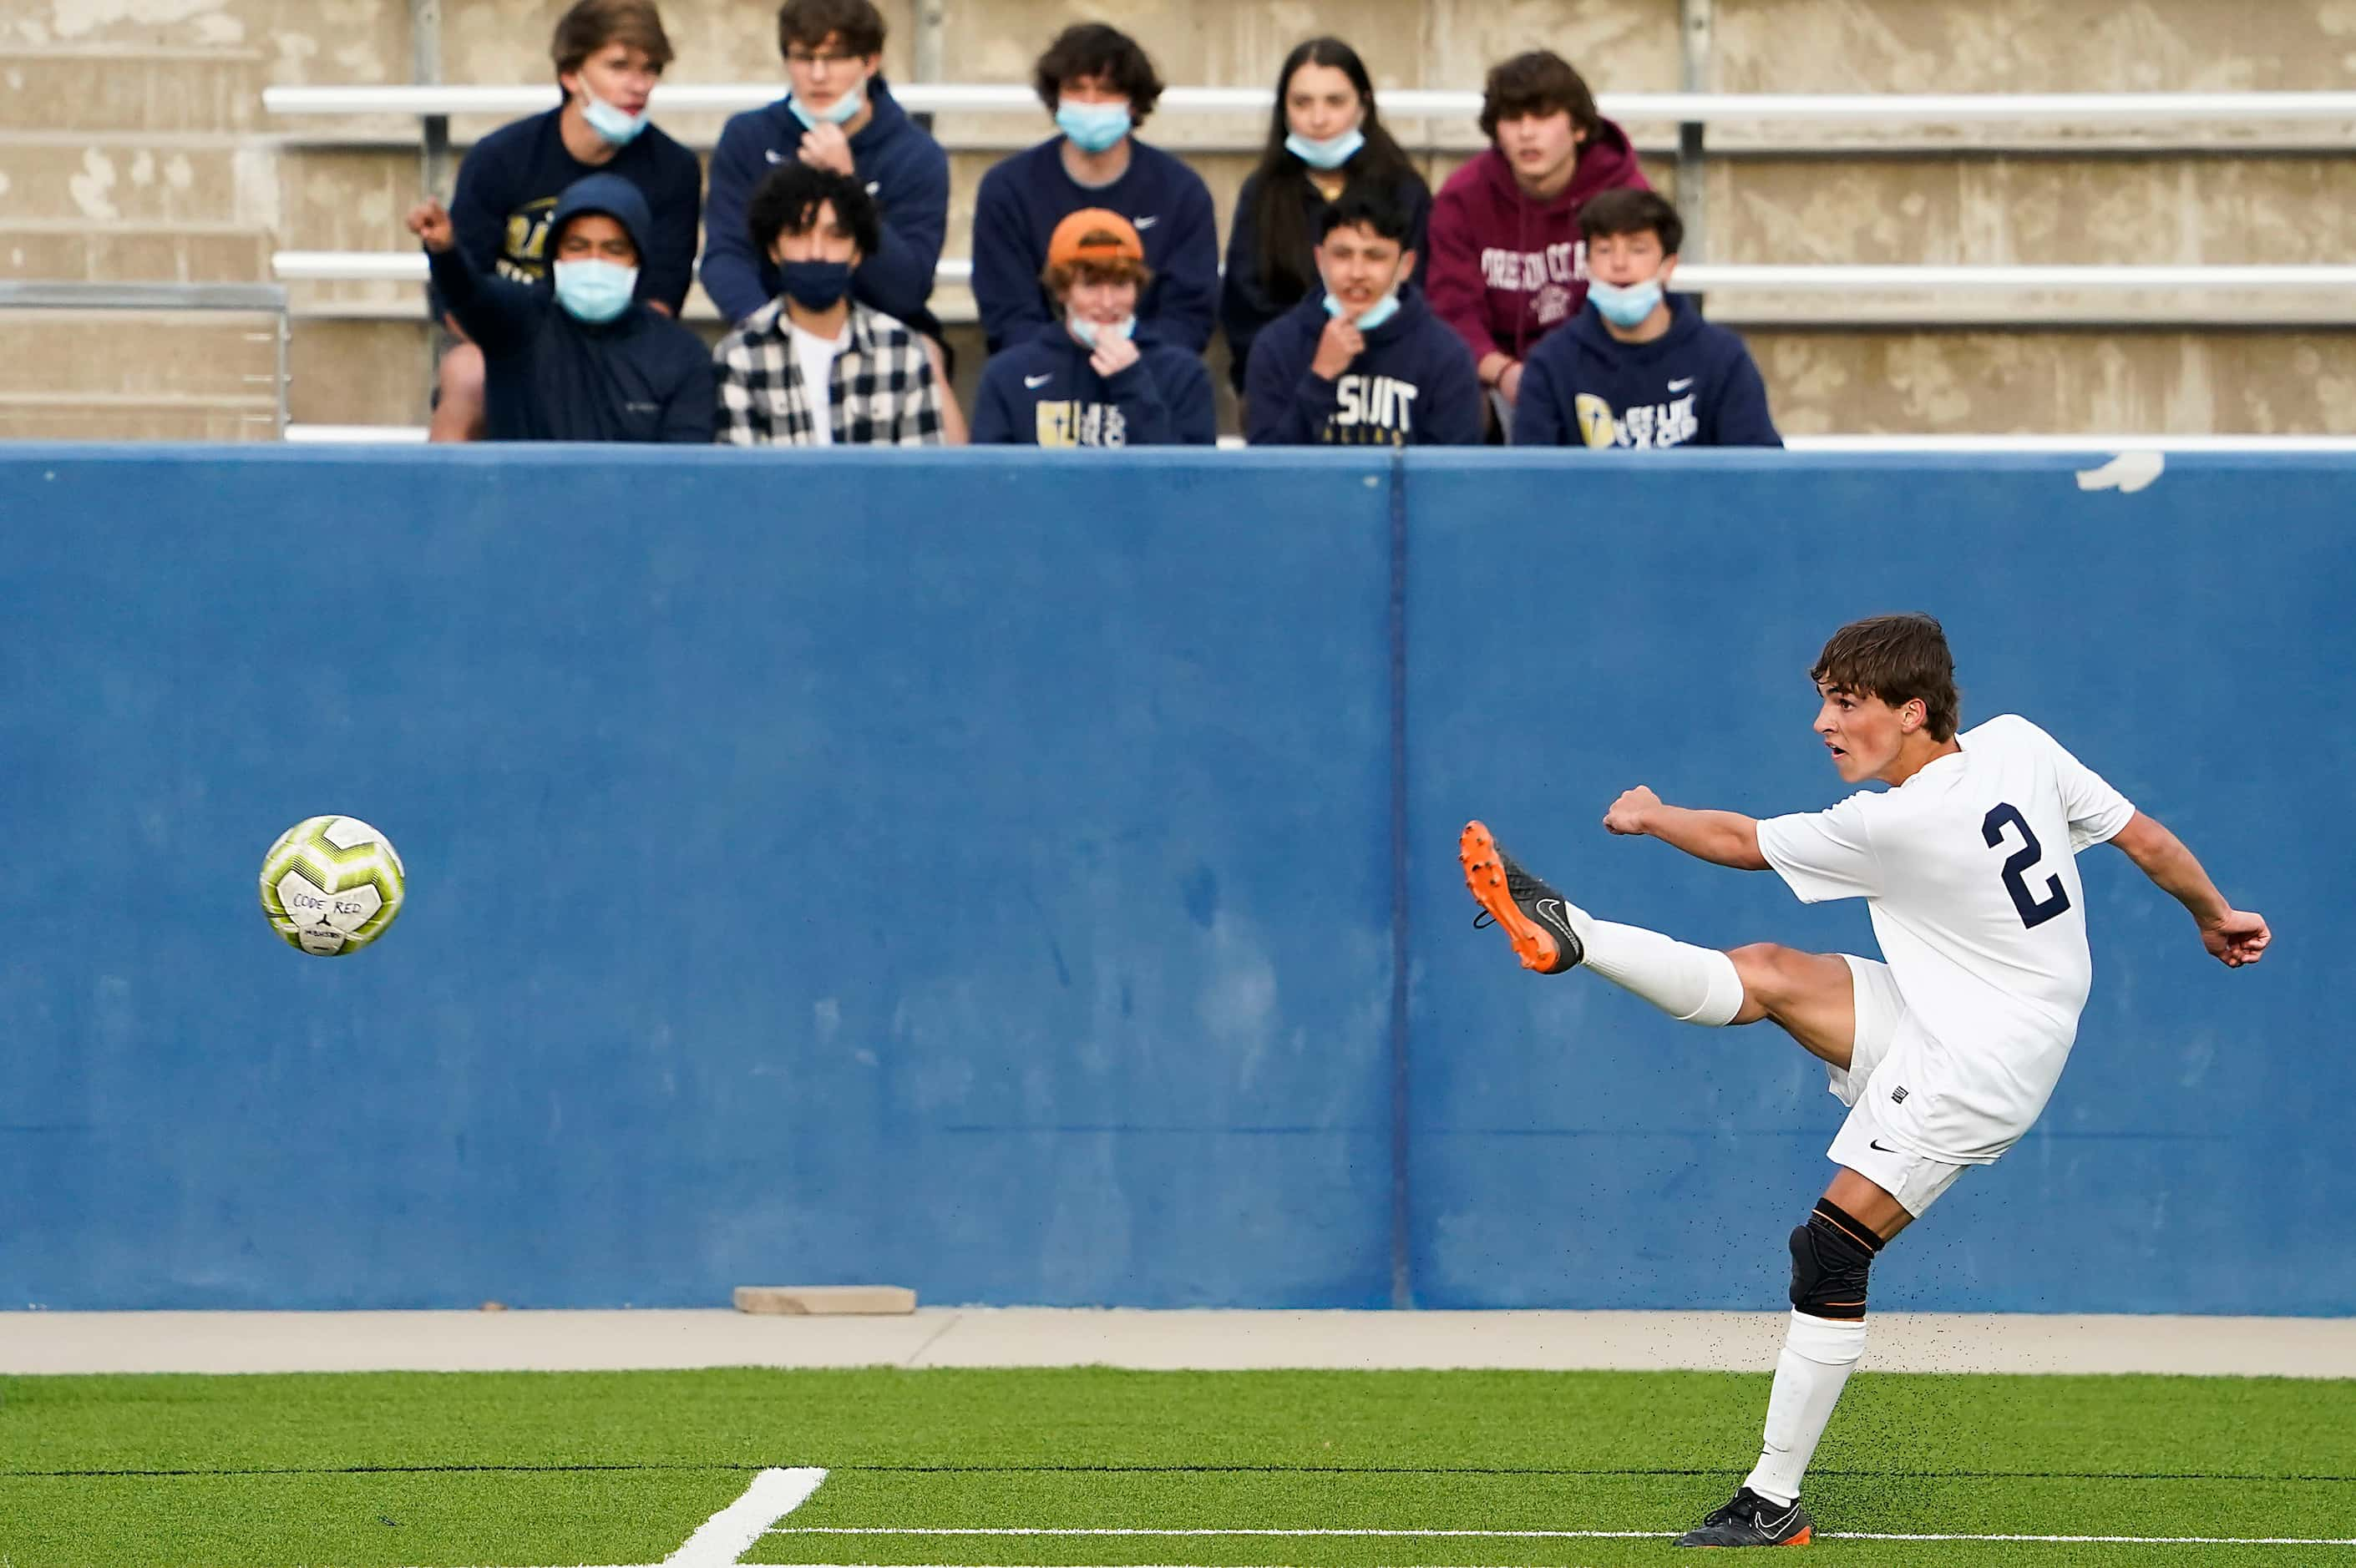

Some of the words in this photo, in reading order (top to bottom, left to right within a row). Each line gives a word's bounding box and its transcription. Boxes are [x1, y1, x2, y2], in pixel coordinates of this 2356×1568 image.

[1335, 375, 1418, 432] SUIT
[1982, 802, 2071, 929] 2
[294, 893, 327, 910] CODE
[334, 902, 362, 914] RED
